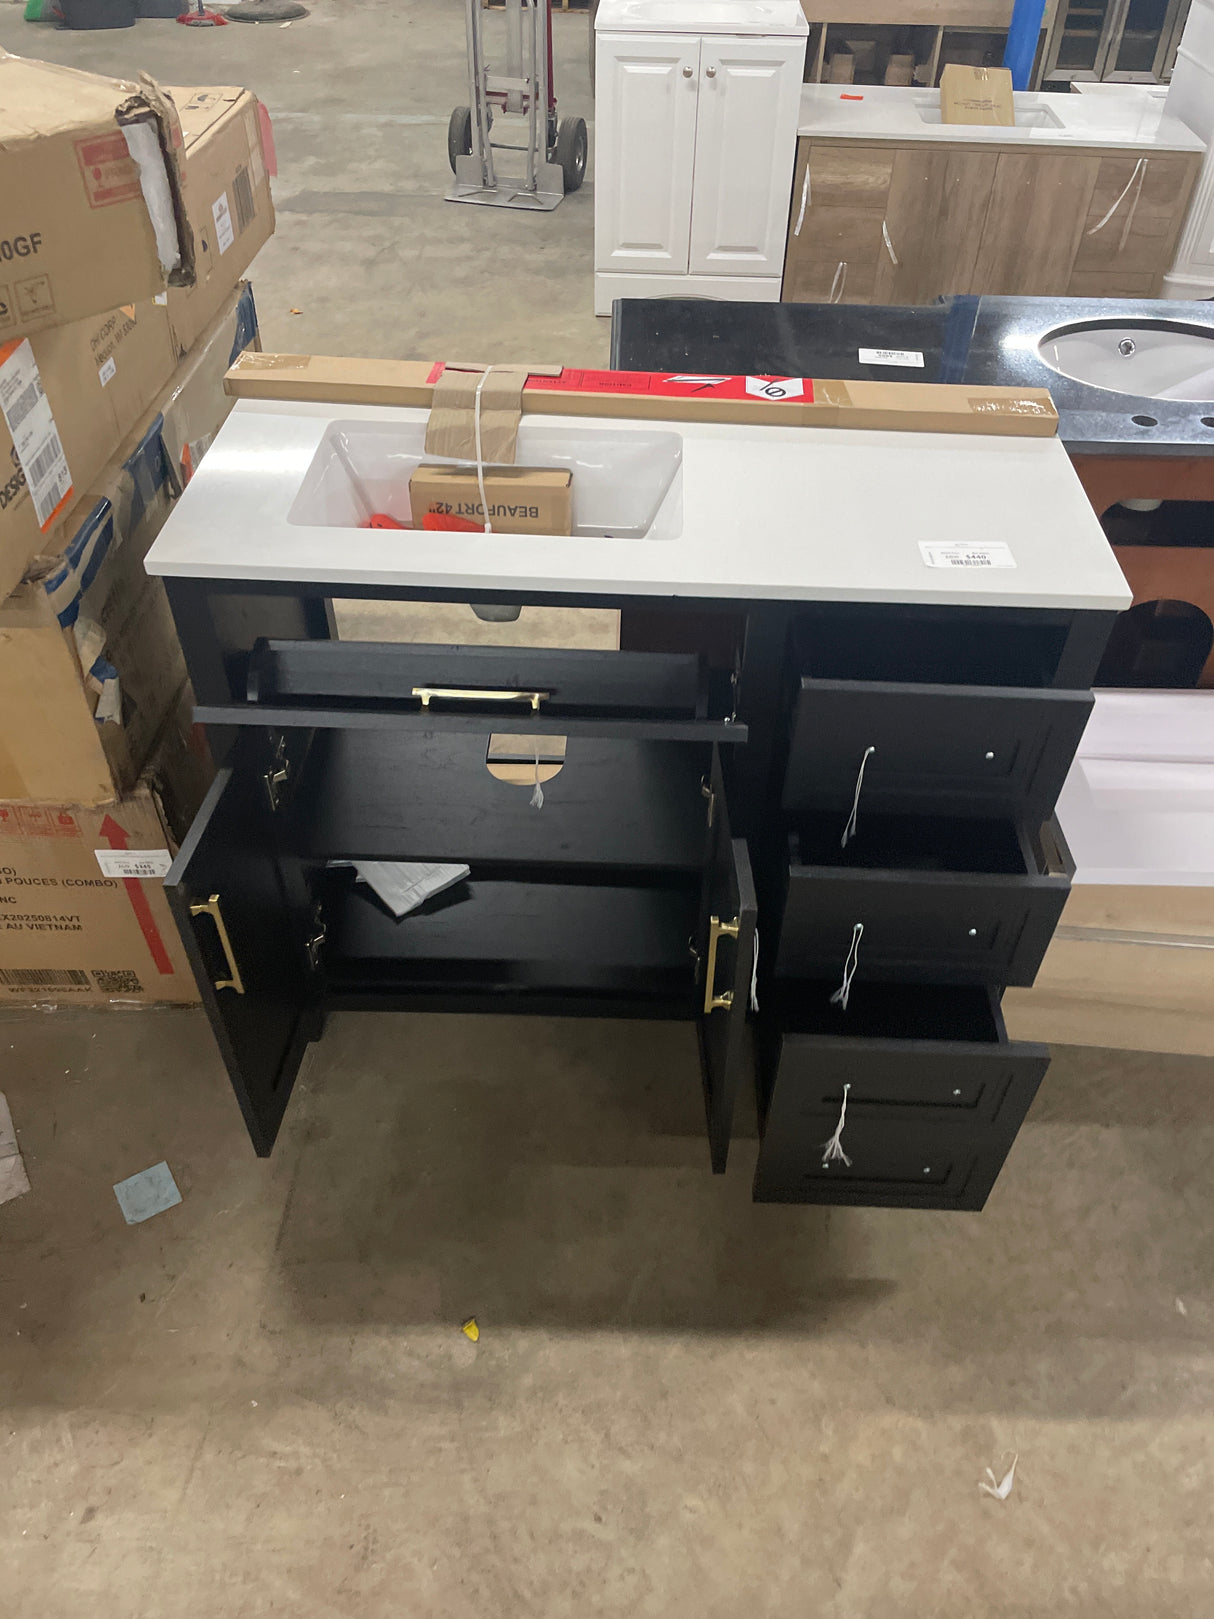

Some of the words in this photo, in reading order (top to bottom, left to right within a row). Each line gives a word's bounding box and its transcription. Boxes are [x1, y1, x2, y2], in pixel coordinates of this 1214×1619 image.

[0, 231, 42, 263] 0GF
[428, 501, 453, 514] 42"
[455, 502, 539, 519] BEAUFORT
[6, 877, 59, 887] POUCES
[62, 878, 118, 889] (COMBO)
[0, 914, 81, 922] X20250814VT
[26, 923, 82, 931] VIETNAM
